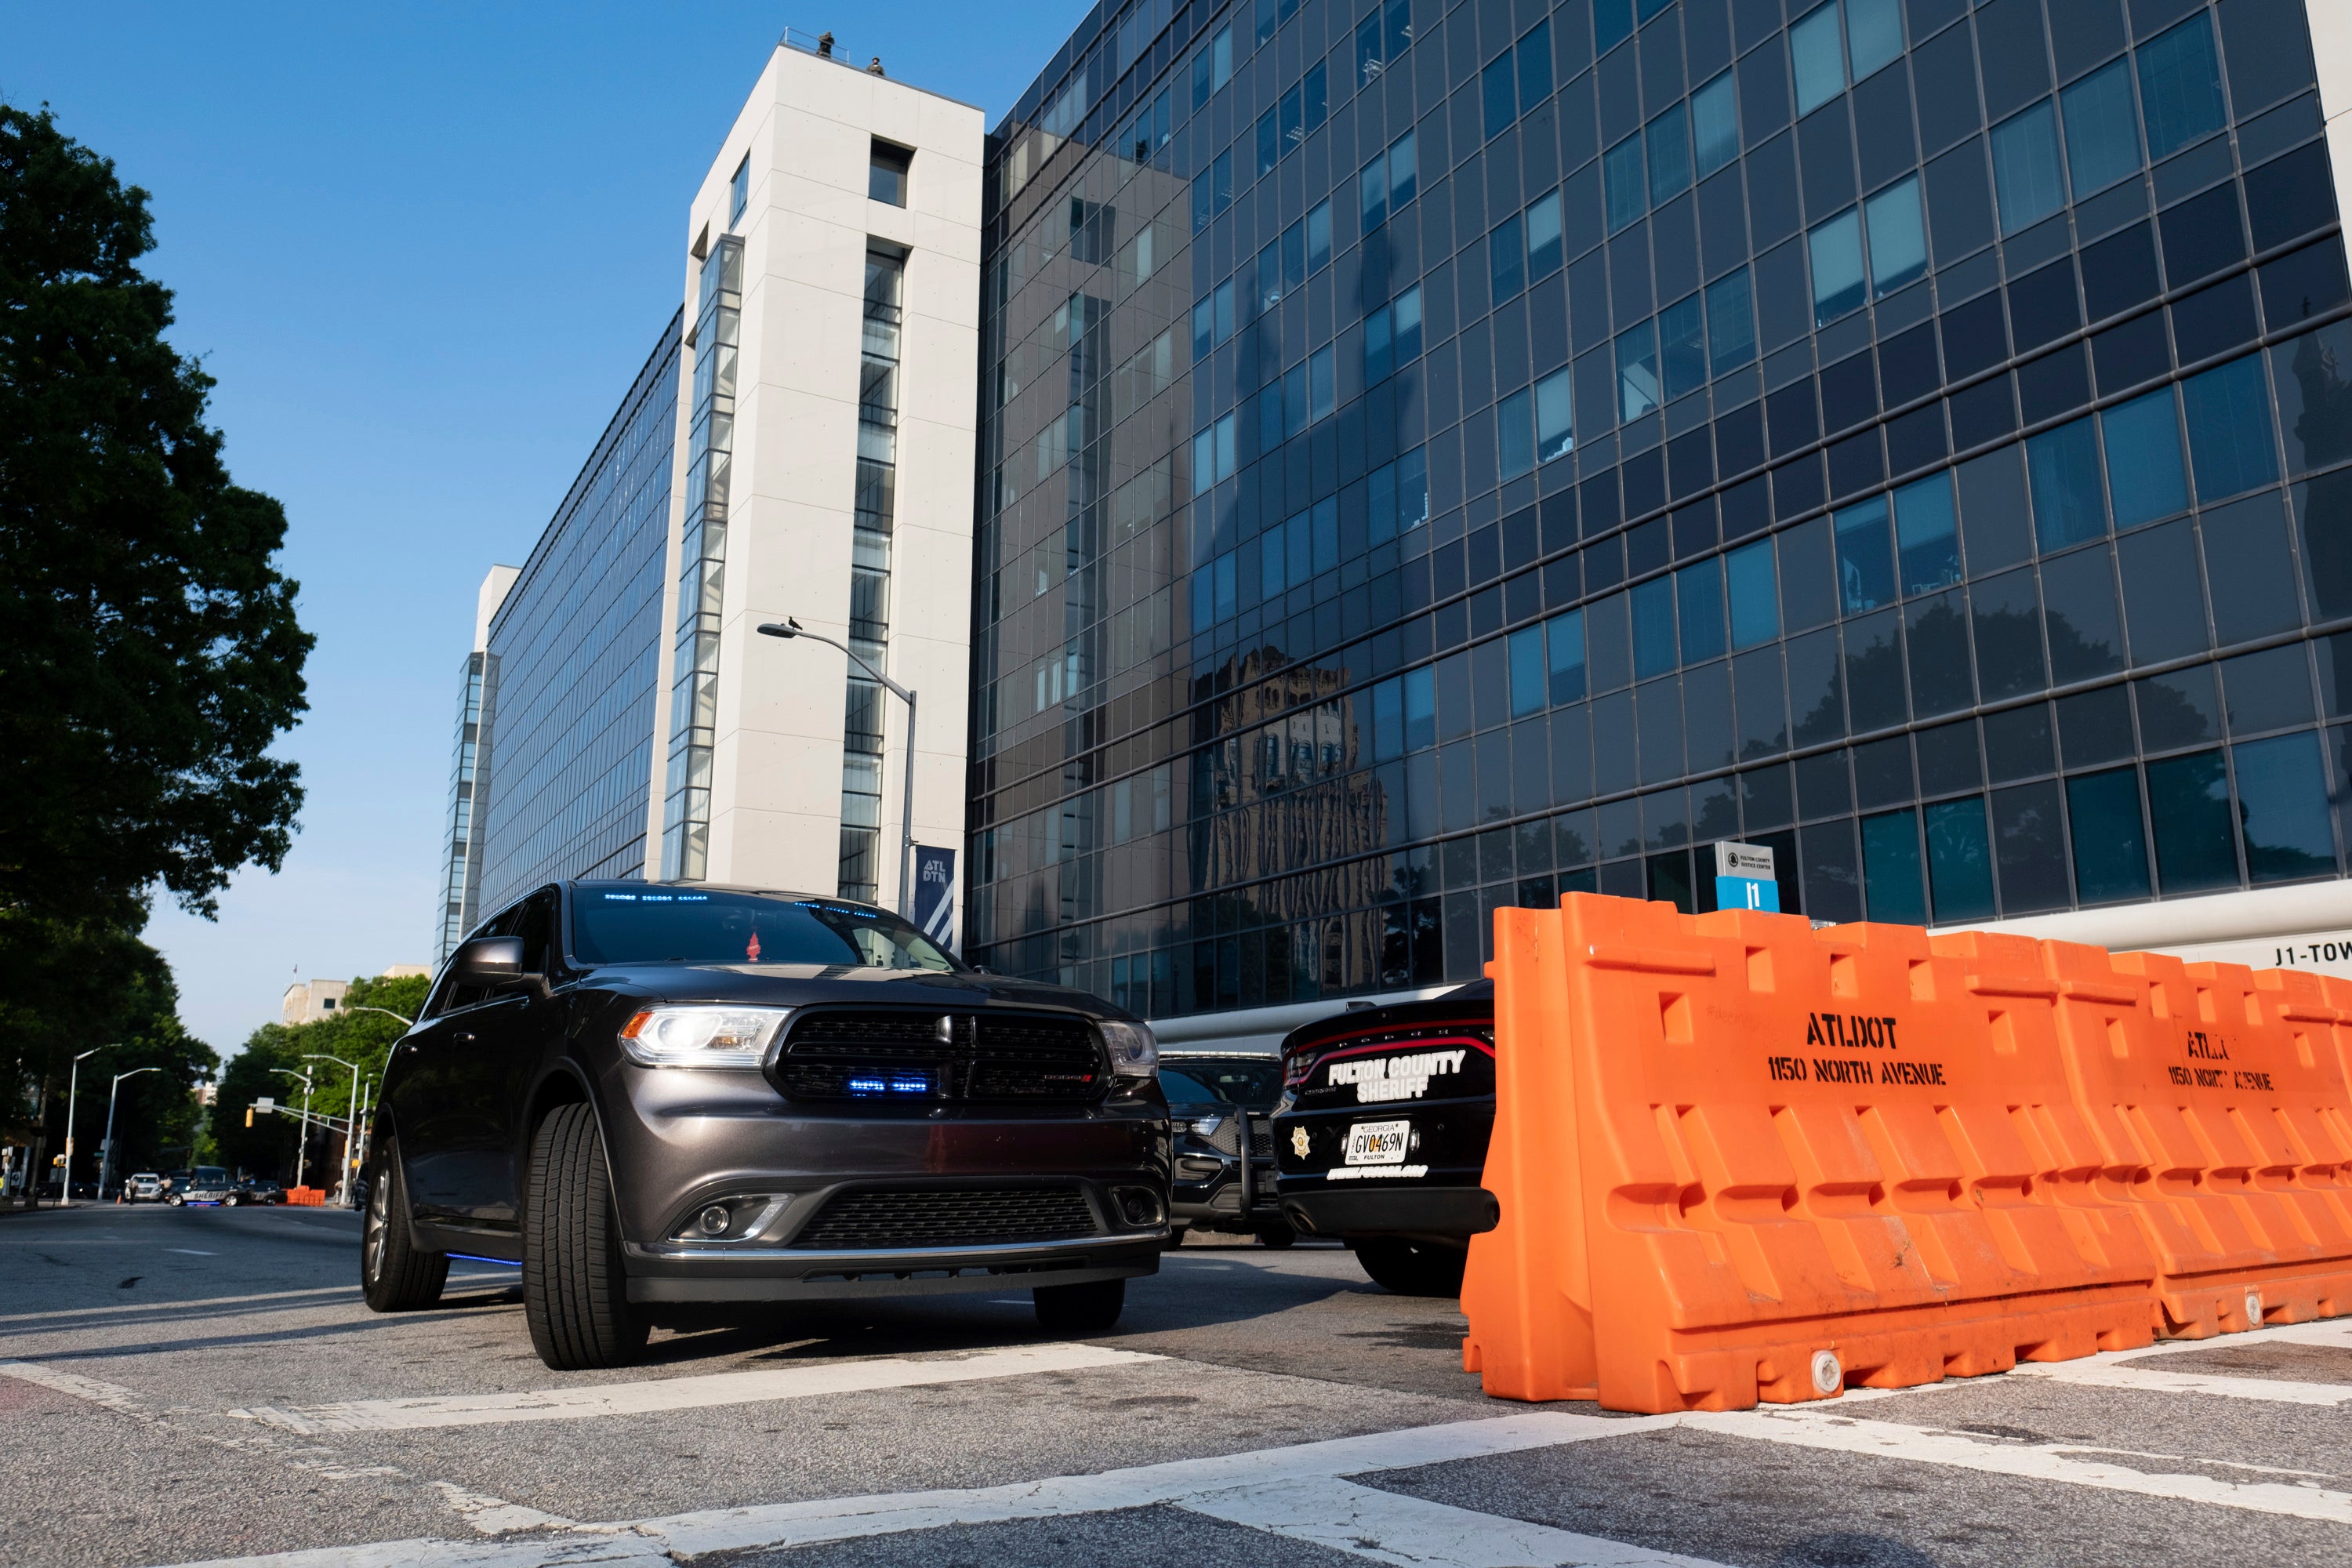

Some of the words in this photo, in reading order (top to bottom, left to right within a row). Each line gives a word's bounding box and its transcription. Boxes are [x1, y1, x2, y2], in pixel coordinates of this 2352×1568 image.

[924, 860, 946, 872] ATL
[923, 870, 946, 883] DTN
[1807, 1012, 1896, 1049] ATLDOT
[1329, 1059, 1387, 1086] FULTON
[1388, 1050, 1466, 1077] COUNTY
[1768, 1057, 1808, 1080] 1150
[1813, 1058, 1874, 1083] NORTH
[1882, 1062, 1946, 1086] AVENUE
[2168, 1066, 2194, 1086] 1150
[1357, 1075, 1428, 1103] SHERIFF
[1363, 1124, 1395, 1133] GEORGIA
[1356, 1132, 1403, 1153] GV0469N
[194, 1191, 225, 1200] SHERIFF
